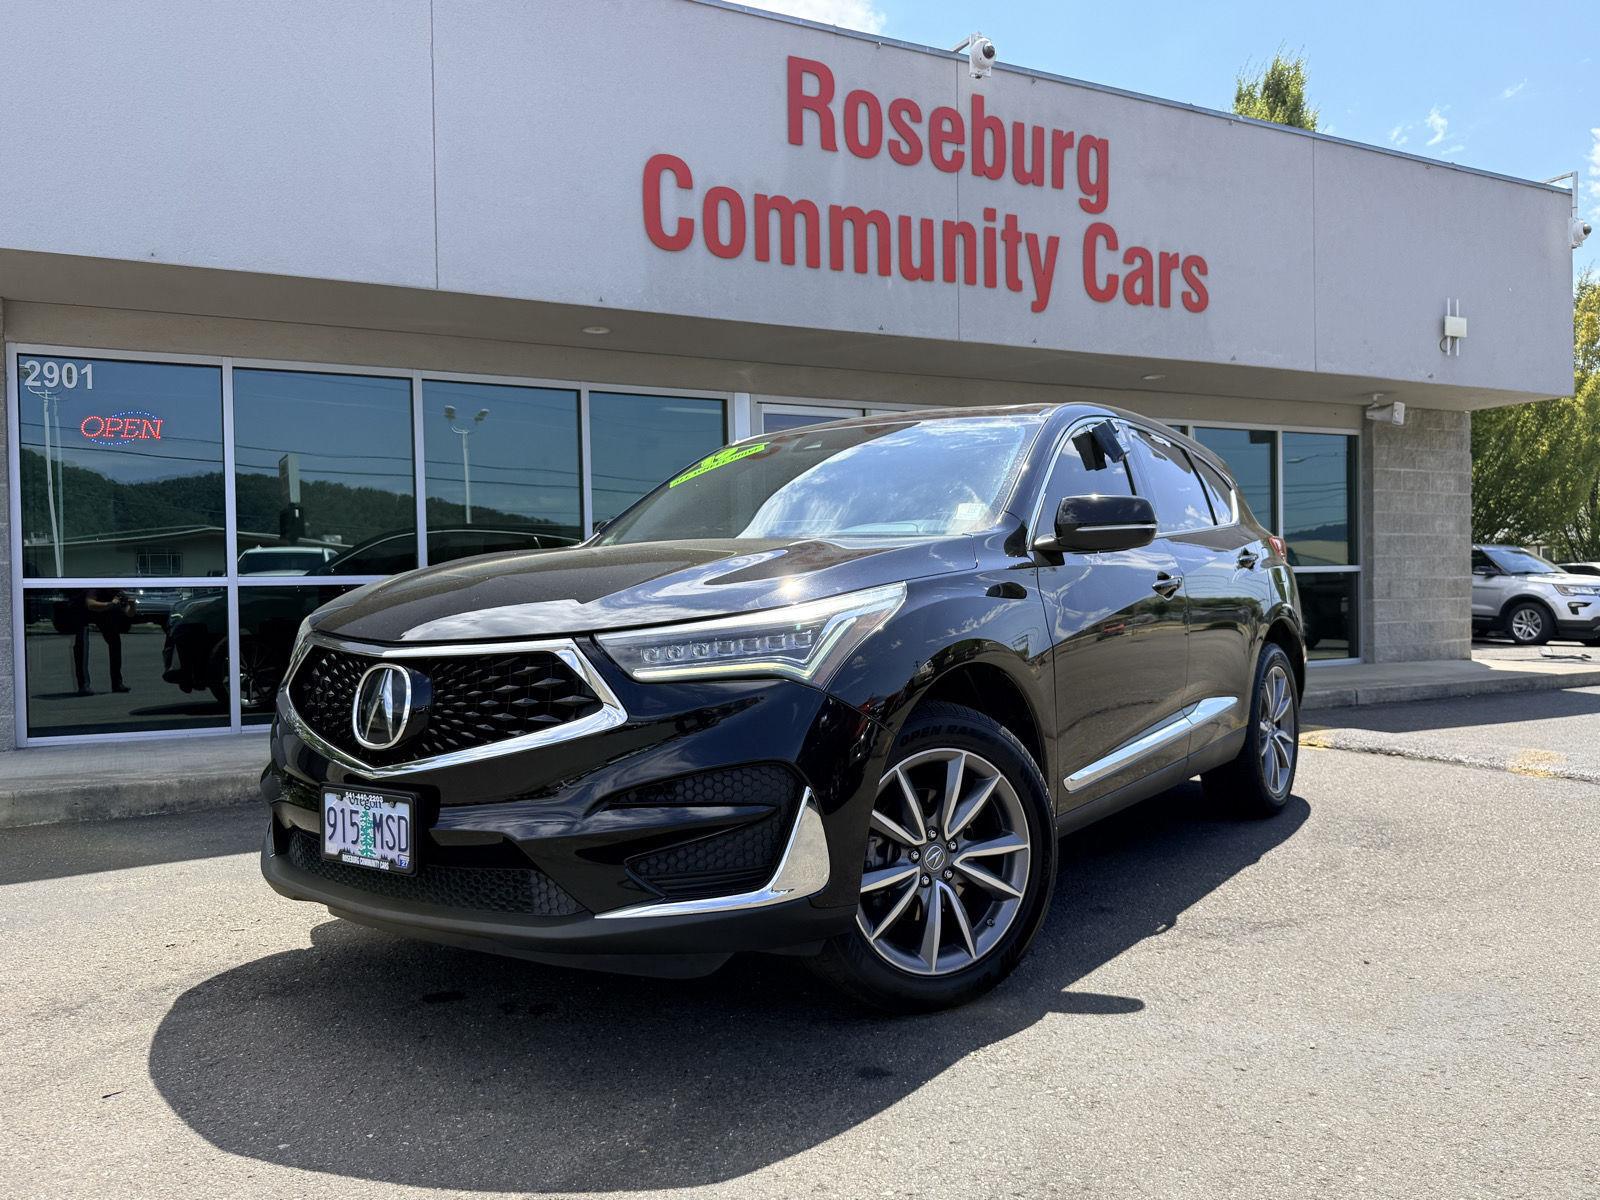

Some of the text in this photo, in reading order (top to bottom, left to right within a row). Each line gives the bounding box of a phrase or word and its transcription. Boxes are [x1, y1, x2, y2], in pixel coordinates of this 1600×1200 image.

[787, 55, 1109, 214] Roseburg
[642, 153, 1210, 313] Community Cars
[24, 360, 93, 390] 2901
[80, 415, 164, 441] OPEN
[693, 459, 726, 475] WHEEL
[730, 447, 761, 460] DRIVE
[899, 724, 943, 747] OPEN
[327, 806, 409, 852] 915 MSD
[380, 861, 389, 870] CARS
